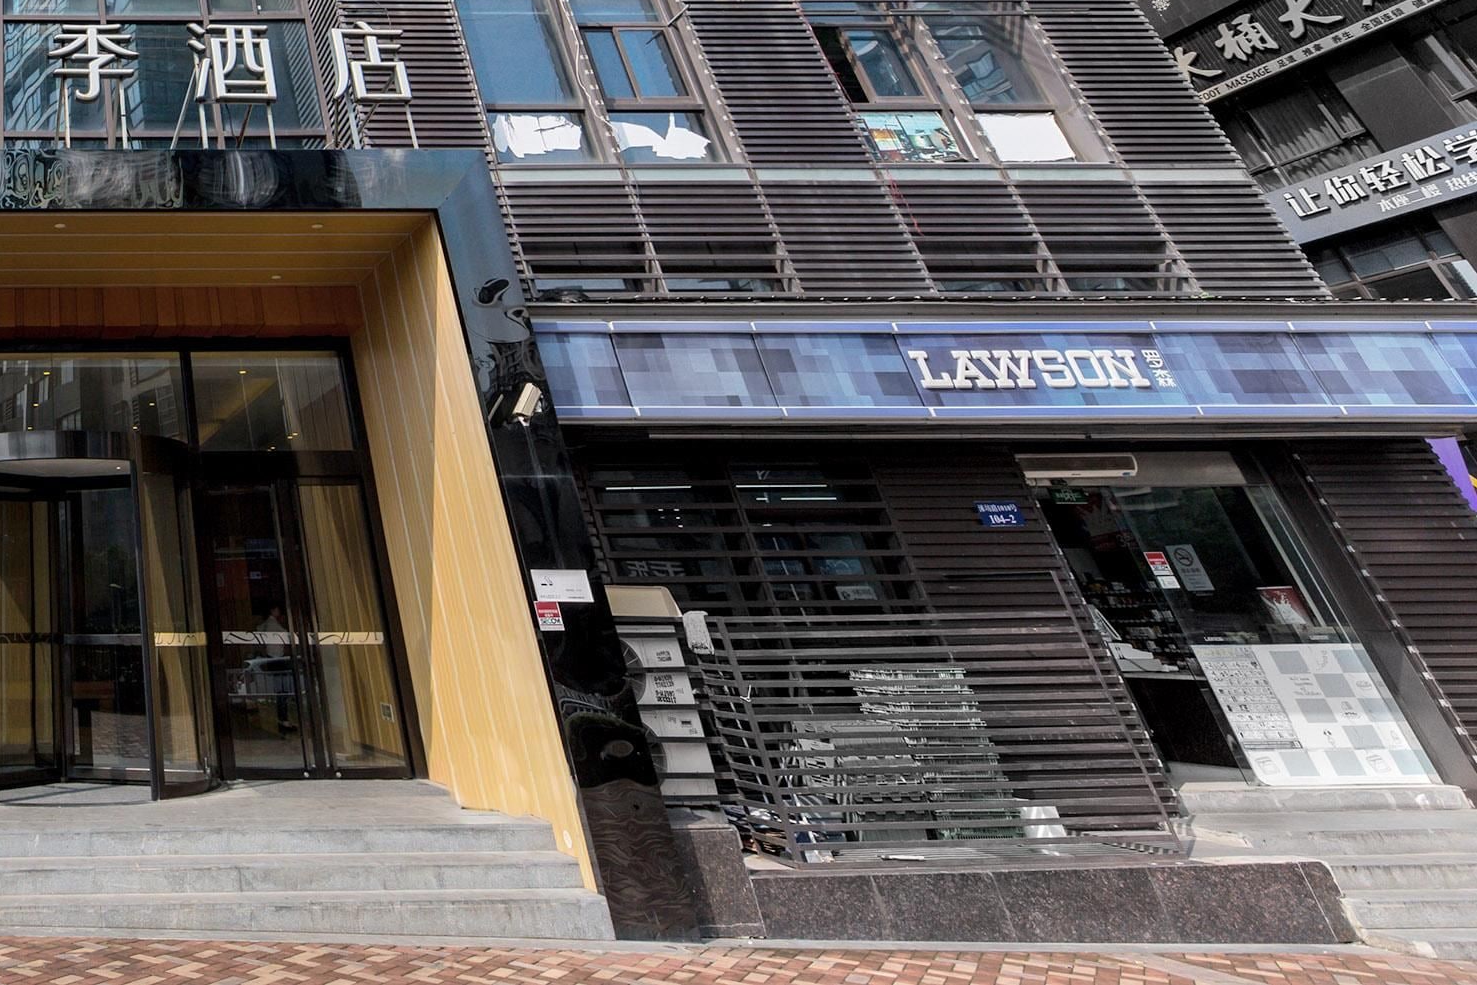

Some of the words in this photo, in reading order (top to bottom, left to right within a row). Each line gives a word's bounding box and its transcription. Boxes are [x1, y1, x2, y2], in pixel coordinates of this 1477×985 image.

[1225, 65, 1272, 91] MASSAGE
[1331, 31, 1354, 44] 养生
[907, 349, 1152, 389] LAWSON
[1141, 349, 1177, 387] 罗森
[989, 514, 1017, 524] 104-2
